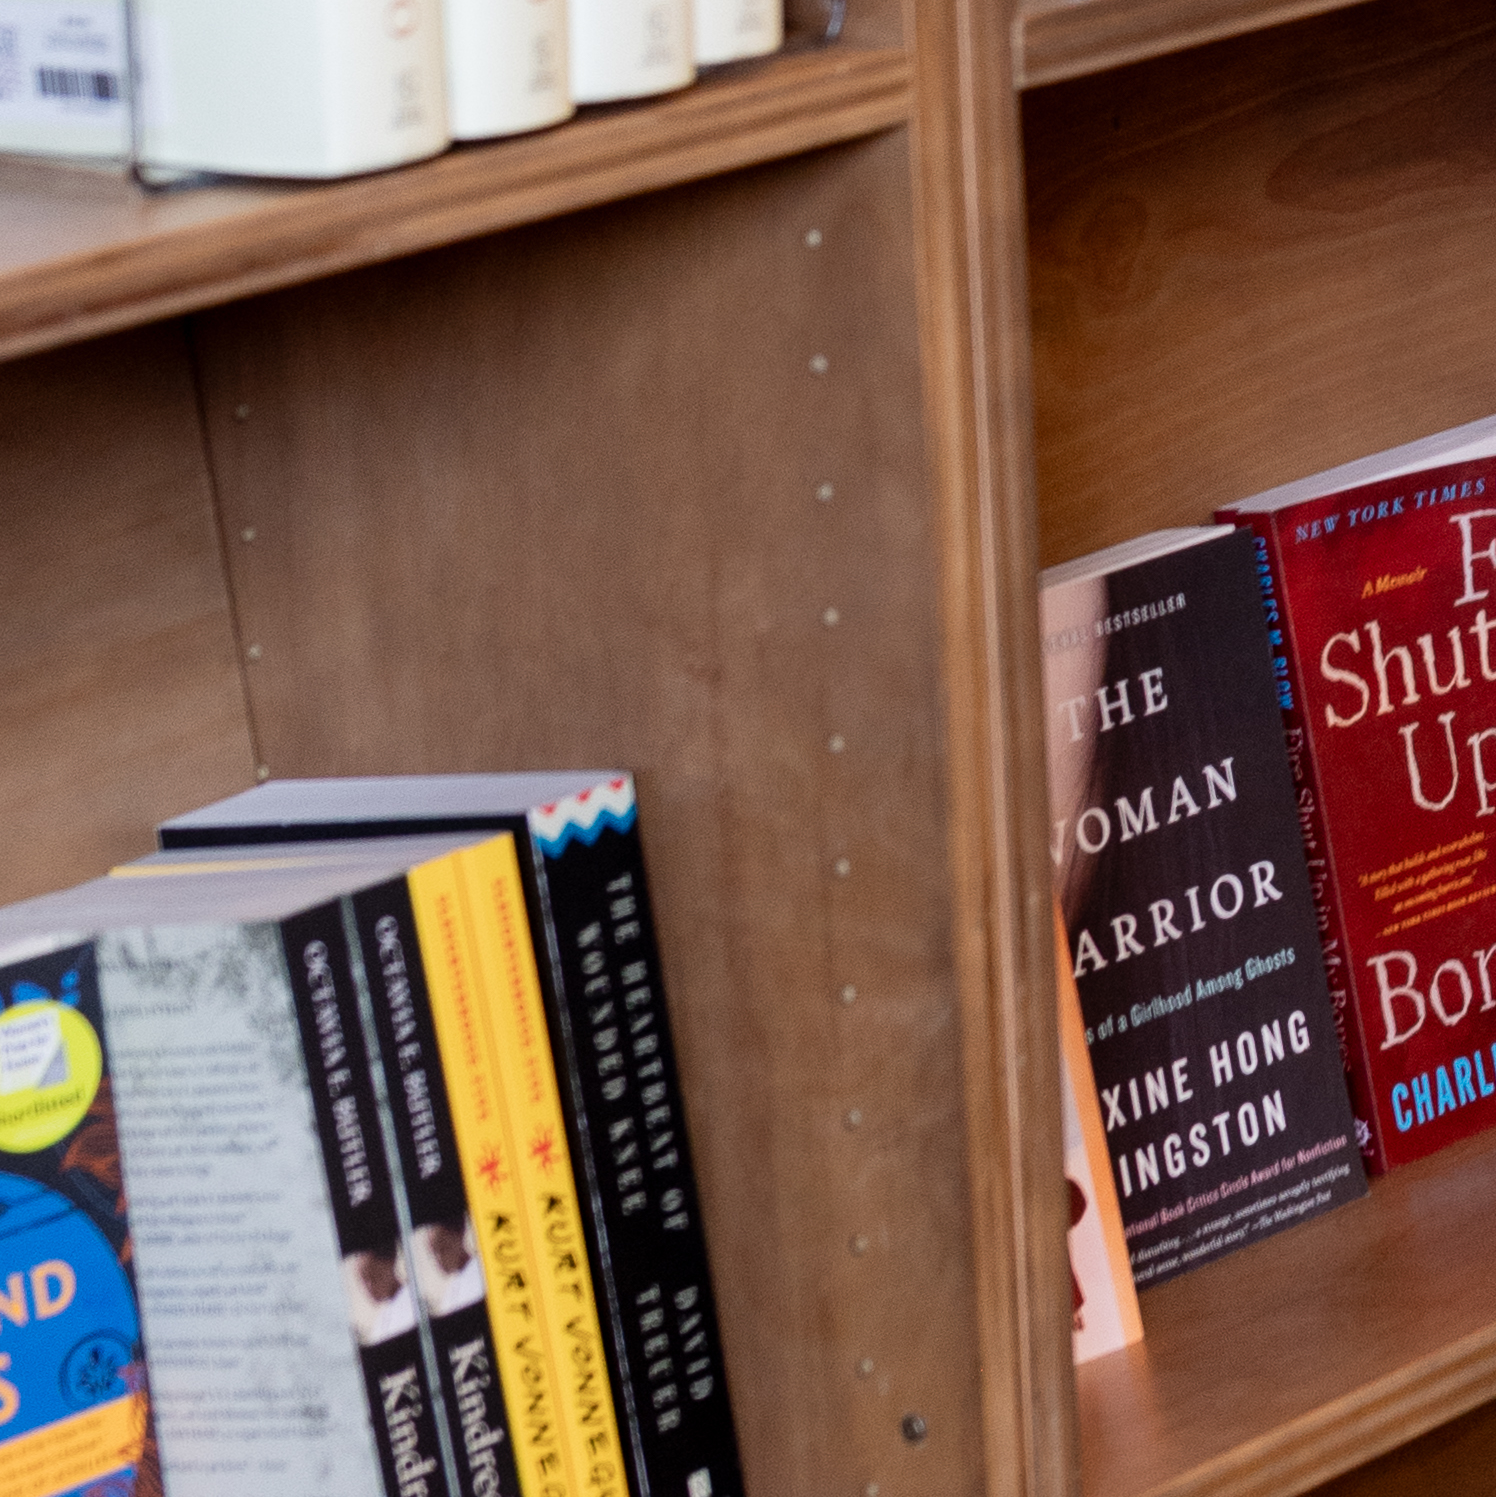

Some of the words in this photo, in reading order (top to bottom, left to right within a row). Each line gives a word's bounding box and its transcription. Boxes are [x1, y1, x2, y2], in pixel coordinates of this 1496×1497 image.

[575, 920, 627, 1103] WOUNDED
[609, 1117, 646, 1217] KNEE
[1210, 1008, 1312, 1086] HONG
